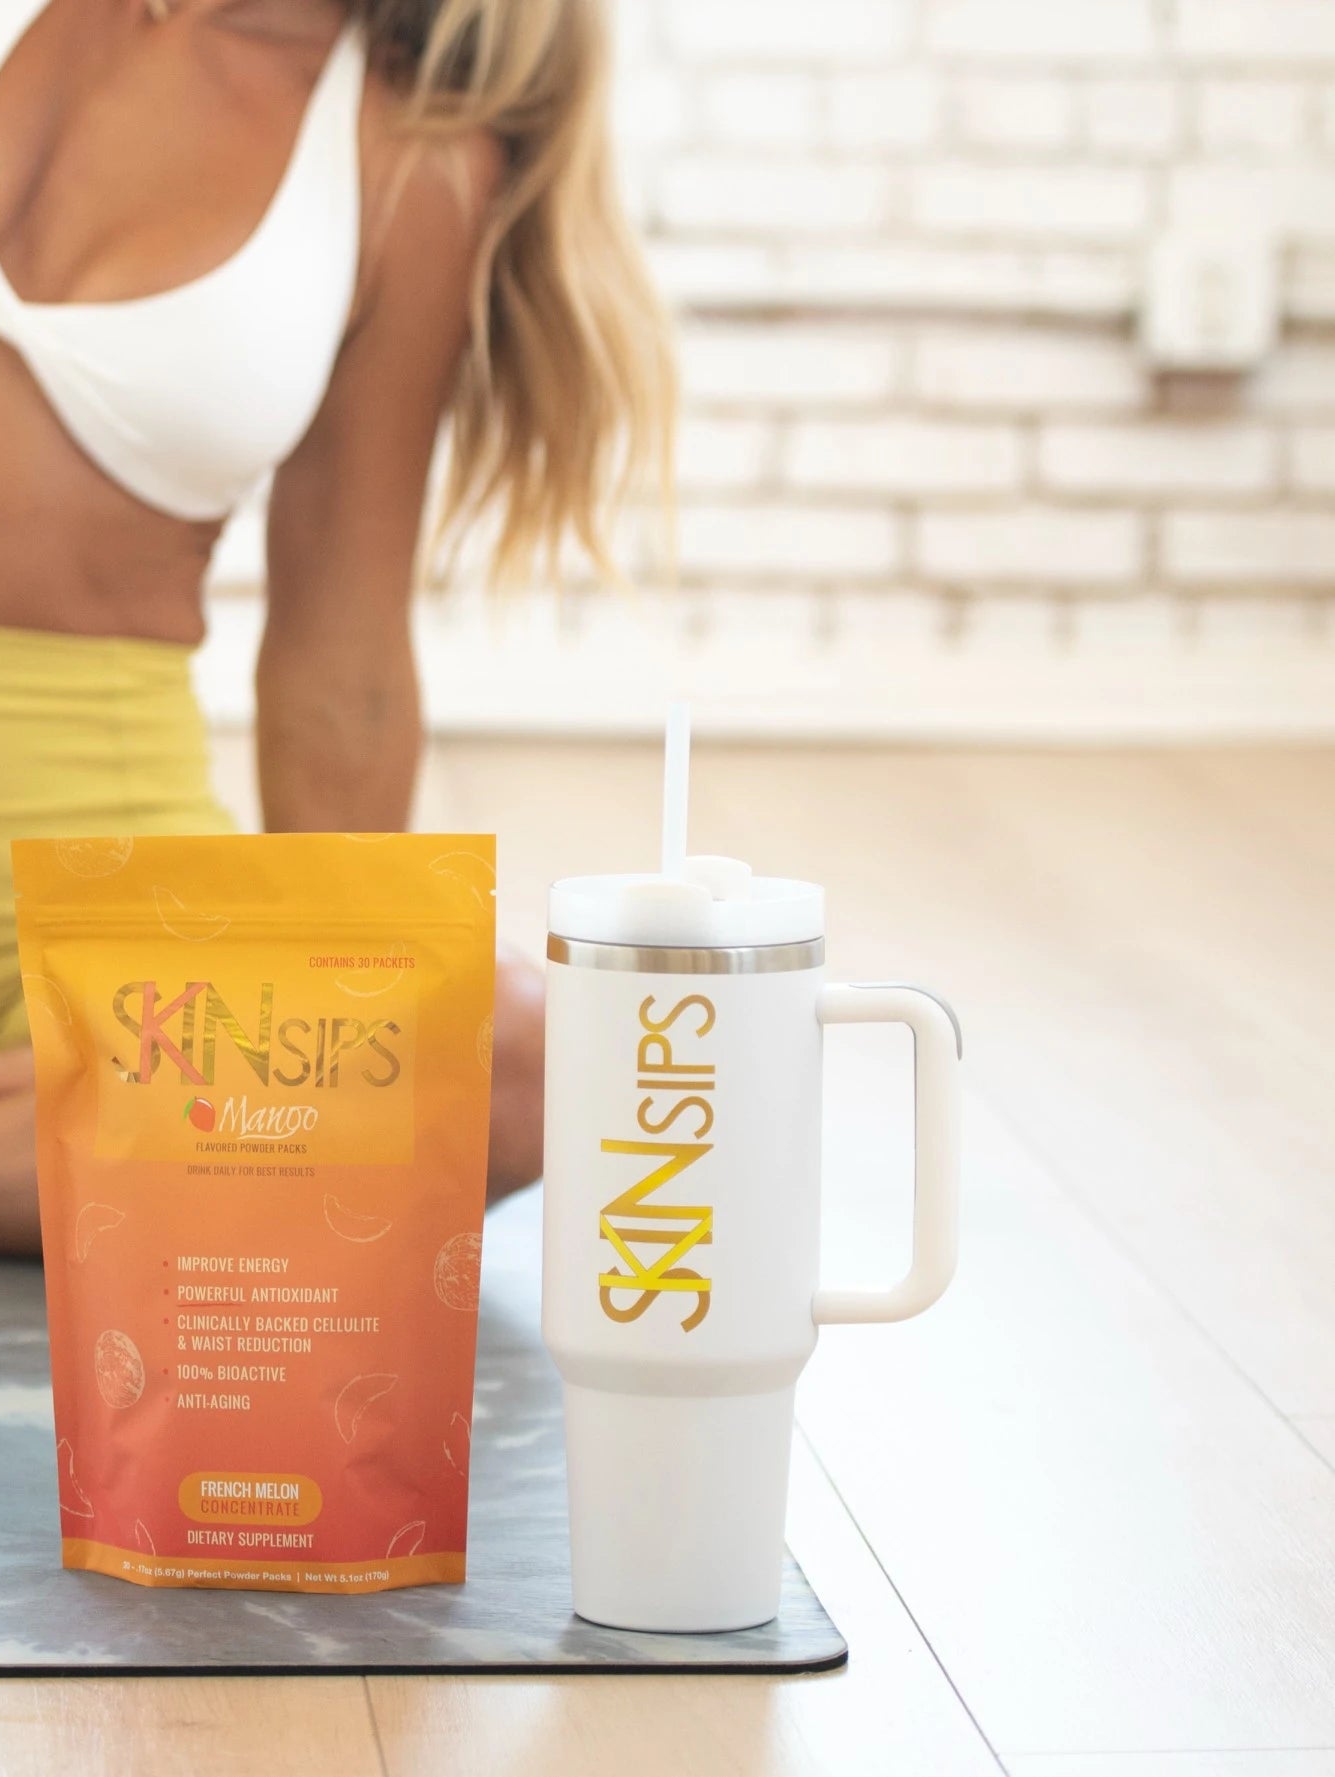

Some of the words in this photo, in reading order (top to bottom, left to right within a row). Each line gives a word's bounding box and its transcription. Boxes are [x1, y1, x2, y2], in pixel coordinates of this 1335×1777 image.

[309, 956, 355, 969] CONTAINS
[357, 957, 370, 969] 30
[373, 957, 416, 969] PACKETS
[218, 1095, 319, 1140] Mango
[196, 1142, 238, 1153] FLAVORED
[240, 1143, 275, 1154] POWDER
[277, 1144, 308, 1155] PACKS
[187, 1165, 212, 1176] DRINK
[213, 1165, 237, 1177] DAILY
[239, 1166, 255, 1177] FOR
[256, 1166, 278, 1178] BEST
[279, 1167, 316, 1178] RESULTS
[177, 1256, 234, 1273] IMPROVE
[238, 1257, 289, 1273] ENERGY
[177, 1285, 246, 1302] POWERFUL
[251, 1287, 339, 1303] ANTIOXIDANT
[177, 1314, 251, 1331] CLINICALLY
[255, 1316, 309, 1332] BACKED
[313, 1317, 380, 1333] CELLULITE
[177, 1335, 187, 1351] &
[191, 1336, 232, 1351] WAIST
[237, 1337, 312, 1353] REDUCTION
[176, 1364, 214, 1380] 100%
[217, 1366, 287, 1382] BIOACTIVE
[176, 1394, 251, 1410] ANTI-AGING
[200, 1480, 252, 1499] FRENCH
[254, 1482, 300, 1500] MELON
[200, 1499, 301, 1516] CONCENTRATE
[187, 1530, 235, 1546] DIETARY
[238, 1532, 315, 1548] SUPPLEMENT
[154, 1569, 185, 1579] (5.67g)
[187, 1570, 222, 1579] Perfect
[224, 1571, 260, 1580] Powder
[262, 1572, 292, 1581] Packs
[305, 1573, 322, 1581] Net
[324, 1573, 338, 1582] Wt
[339, 1574, 363, 1583] 5.1oz
[364, 1570, 390, 1582] (170g)
